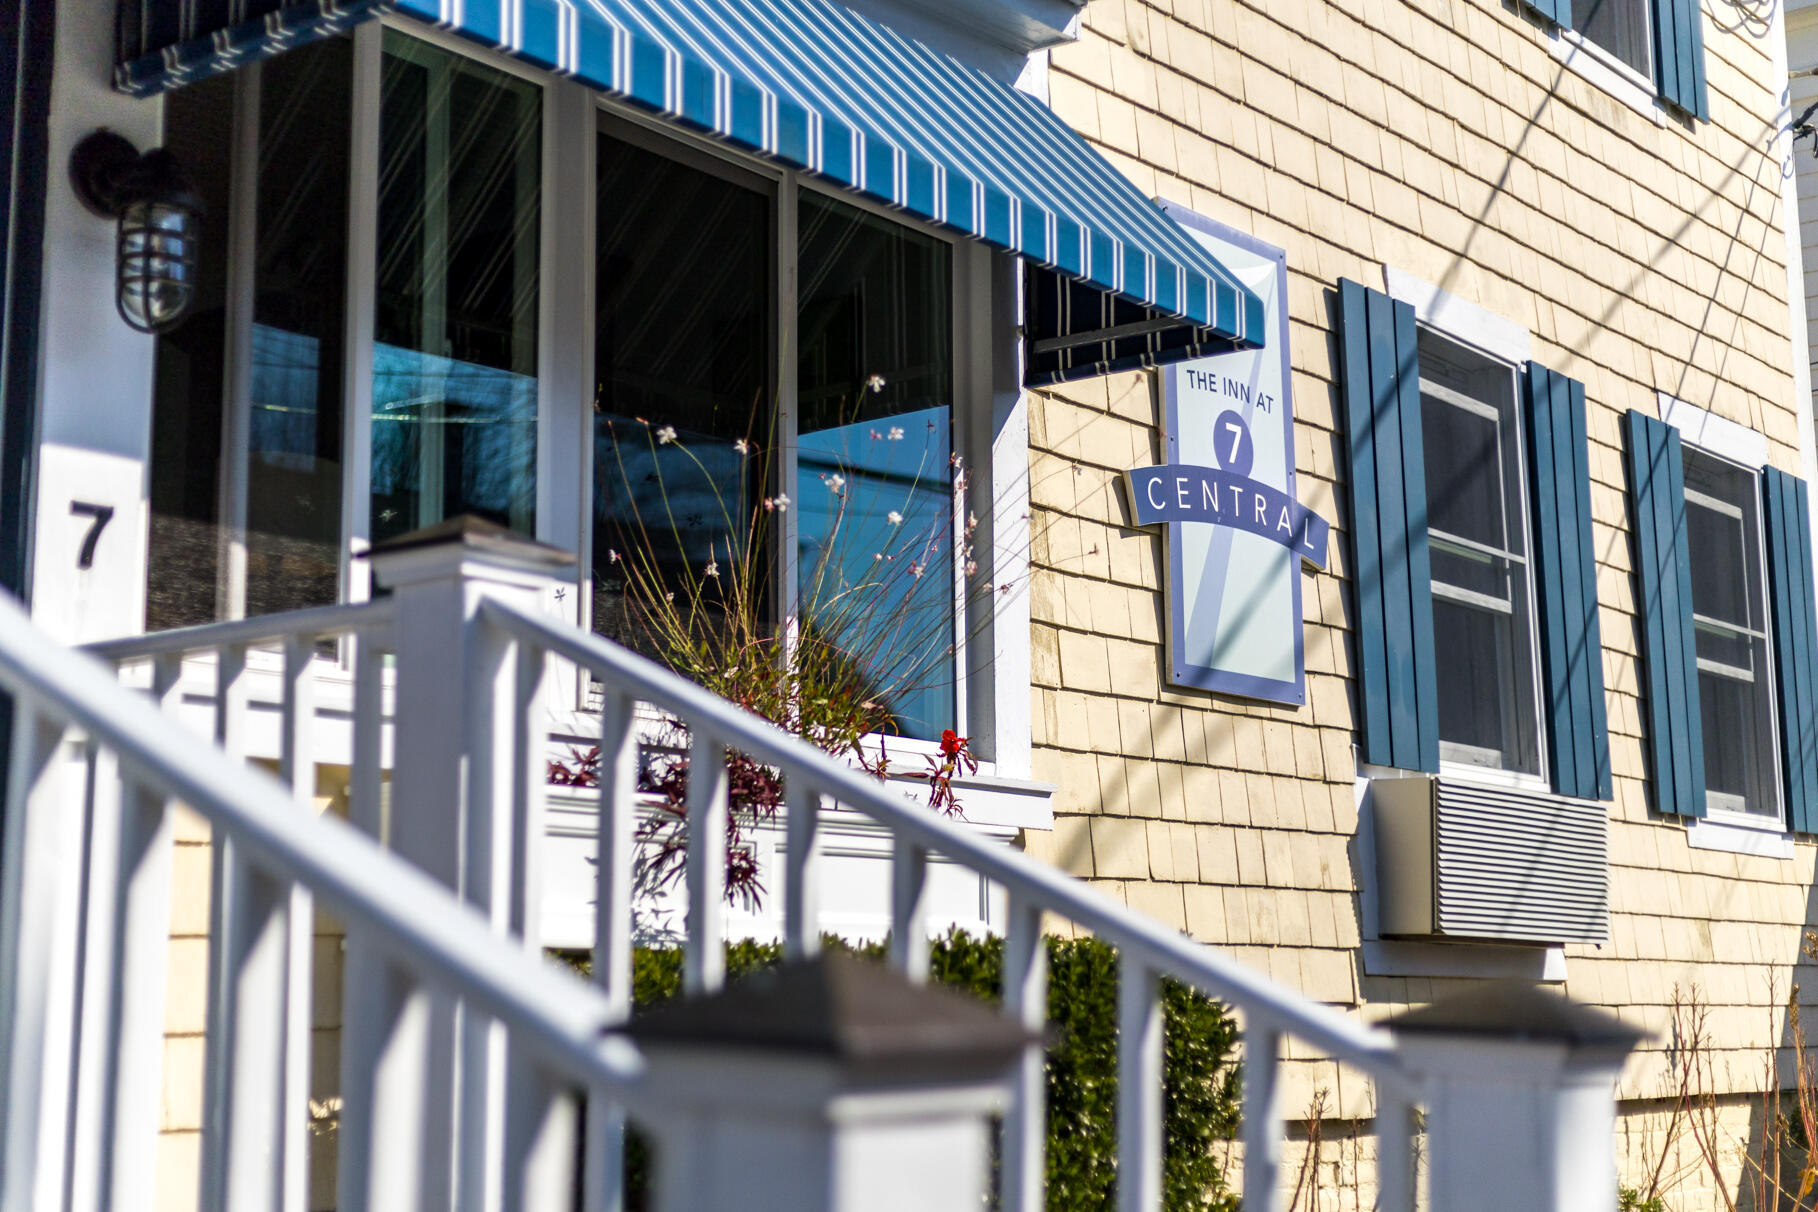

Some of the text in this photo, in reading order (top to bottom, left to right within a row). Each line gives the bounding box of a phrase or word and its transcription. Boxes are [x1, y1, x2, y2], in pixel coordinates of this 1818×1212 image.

[1186, 369, 1274, 414] THE INN AT
[1225, 422, 1242, 464] 7
[70, 500, 114, 570] 7
[1147, 477, 1315, 550] CENTRAL
